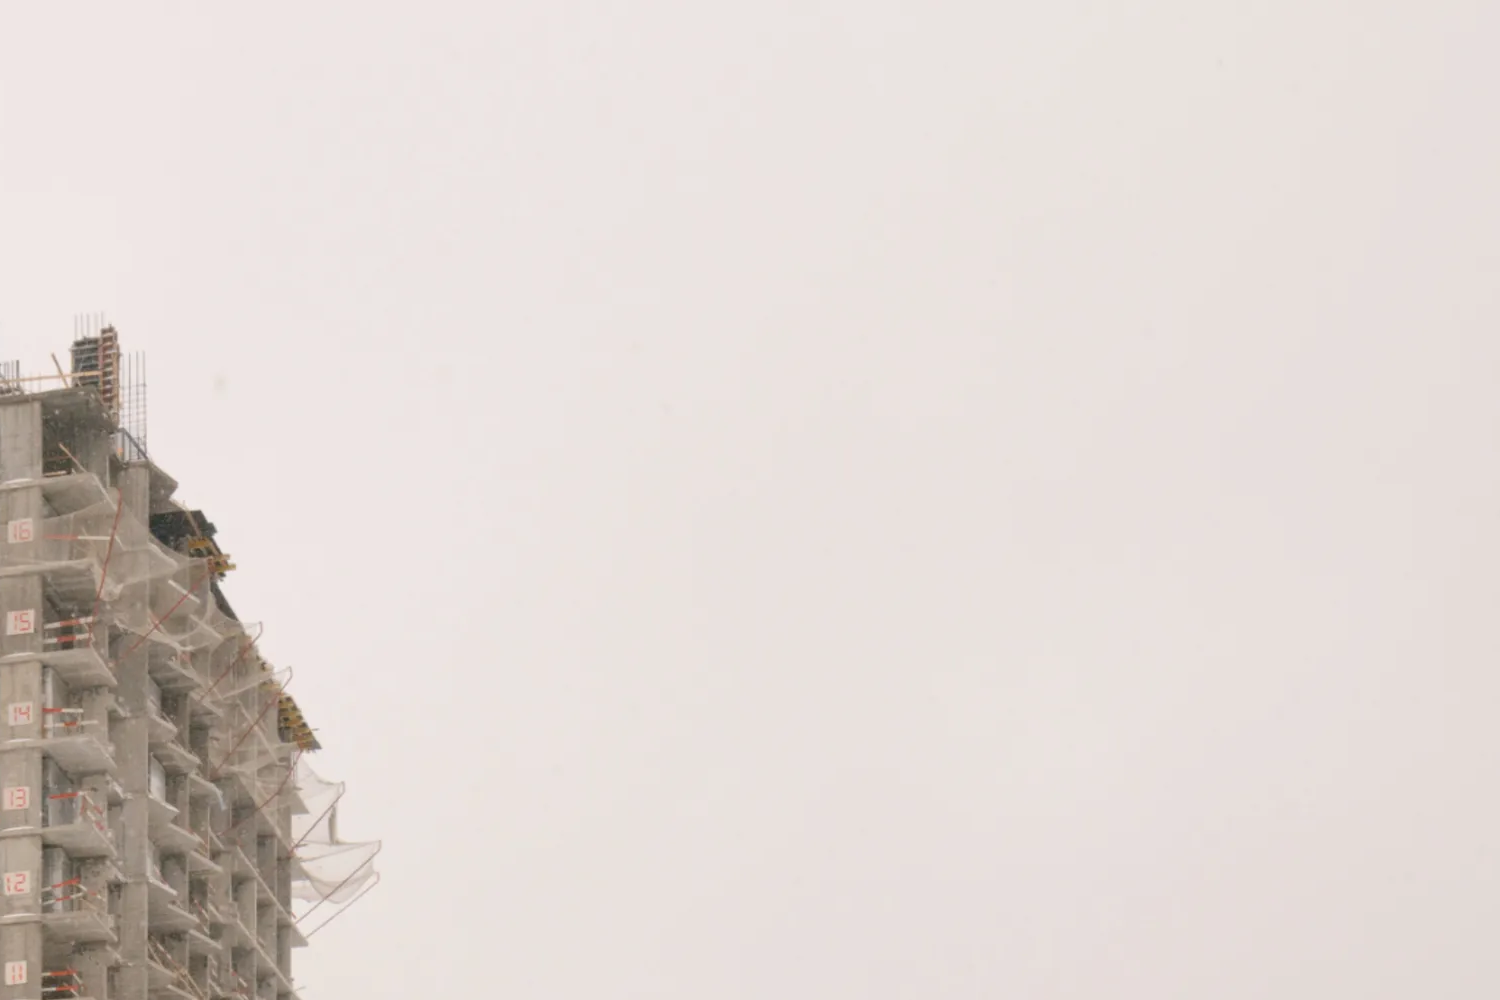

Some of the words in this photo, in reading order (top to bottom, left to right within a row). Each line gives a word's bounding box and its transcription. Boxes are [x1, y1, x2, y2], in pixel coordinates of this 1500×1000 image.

[13, 522, 31, 541] 16
[13, 612, 31, 632] 15
[14, 704, 31, 721] 14
[10, 788, 27, 809] 13
[5, 873, 27, 893] 12
